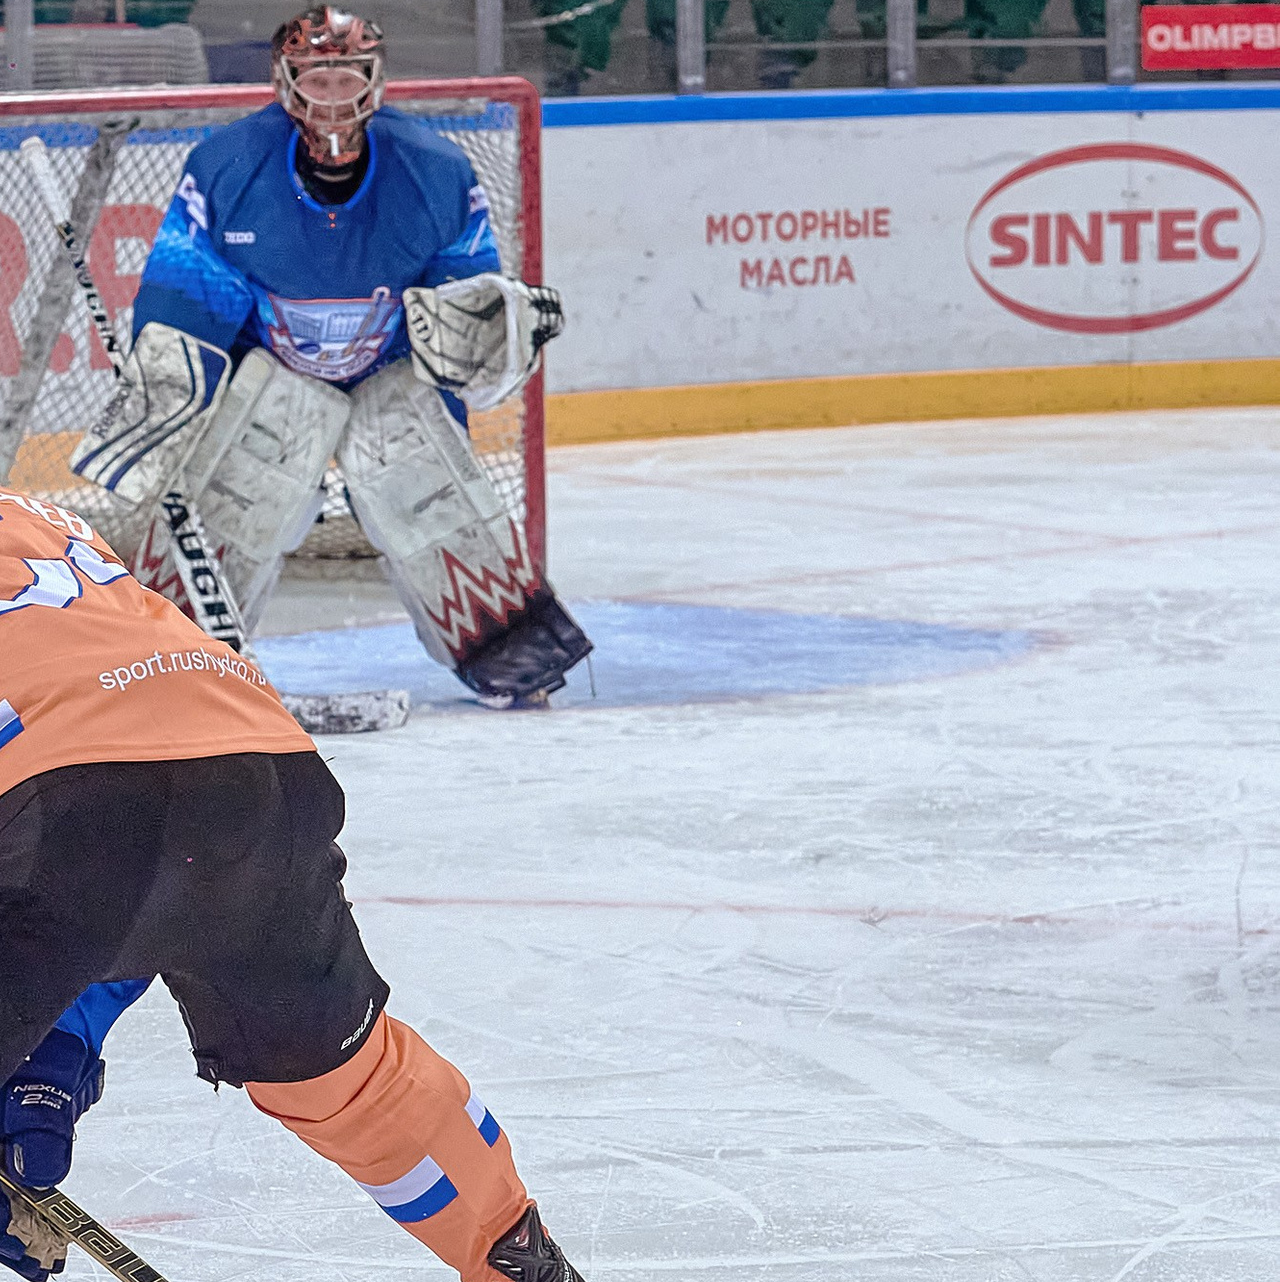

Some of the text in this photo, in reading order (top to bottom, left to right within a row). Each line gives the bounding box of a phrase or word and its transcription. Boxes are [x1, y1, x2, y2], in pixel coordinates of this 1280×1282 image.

[1147, 22, 1280, 52] OLIMPB
[326, 132, 340, 157] 1
[706, 207, 891, 245] МОТОРНЫЕ
[989, 208, 1240, 268] SINTEC
[740, 255, 857, 288] МАСЛА
[13, 1084, 72, 1102] NEXUS
